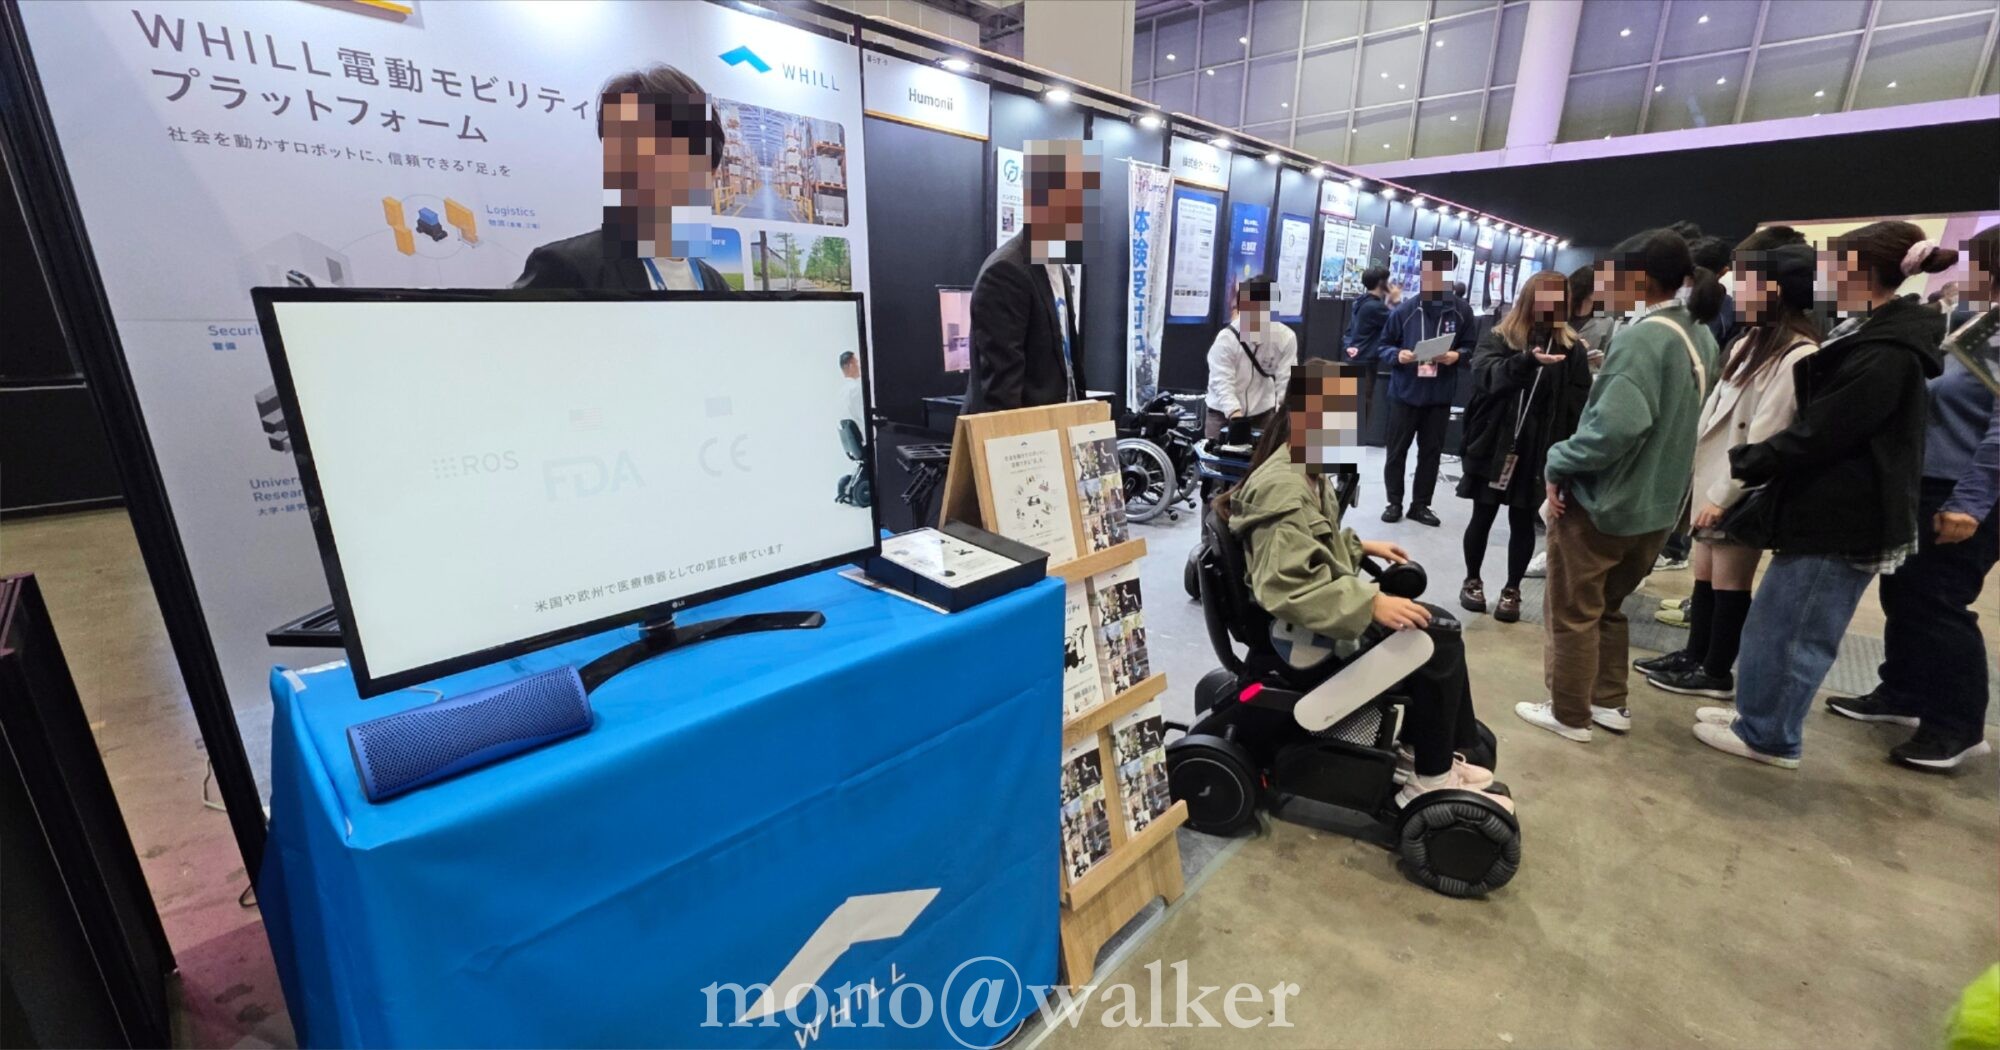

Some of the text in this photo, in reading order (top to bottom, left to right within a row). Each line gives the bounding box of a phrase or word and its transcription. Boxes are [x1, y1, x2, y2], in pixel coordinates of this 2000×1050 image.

[131, 9, 590, 121] WHILL電動モビリティ
[782, 62, 840, 92] WHILL
[151, 66, 488, 143] プラットフォーム
[908, 87, 954, 112] Humonii
[167, 125, 512, 178] 社会を動かすロボットに、信頼できる「足」を
[485, 203, 536, 217] Logistics
[207, 322, 260, 338] Securi
[461, 449, 520, 476] ROS
[697, 432, 753, 478] CE
[249, 475, 301, 491] Univer
[252, 488, 304, 503] Resear
[541, 450, 648, 503] FDA
[534, 541, 784, 613] 米国や欧州で医療機器としての認証を得ています
[794, 961, 907, 1049] WHILL
